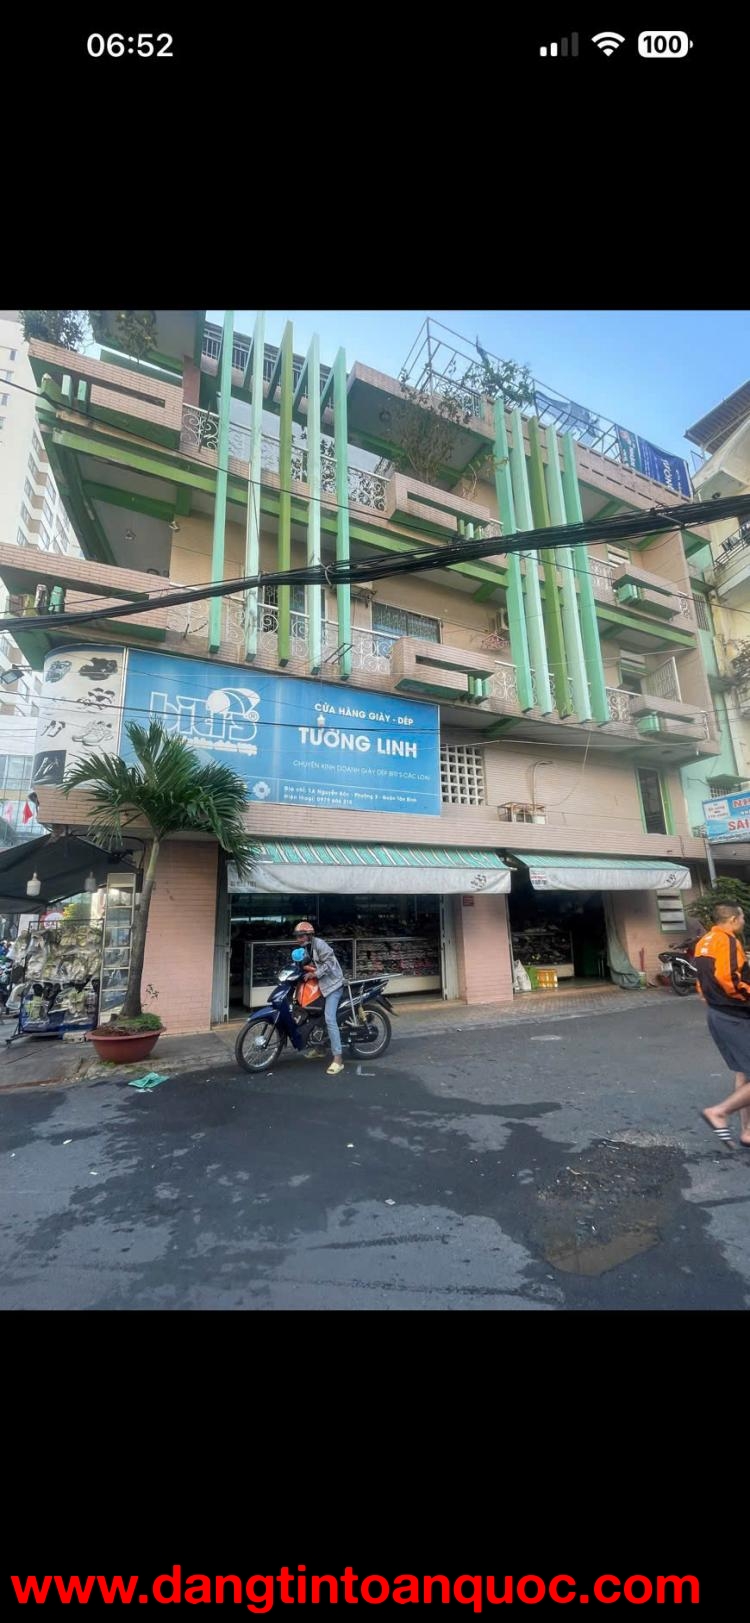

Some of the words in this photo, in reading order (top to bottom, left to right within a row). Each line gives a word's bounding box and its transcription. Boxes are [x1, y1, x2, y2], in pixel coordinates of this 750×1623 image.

[314, 702, 336, 714] CỬA
[338, 706, 366, 719] HÀNG
[368, 711, 391, 723] GIÀY
[397, 715, 414, 726] DÉP
[377, 738, 418, 759] LINH
